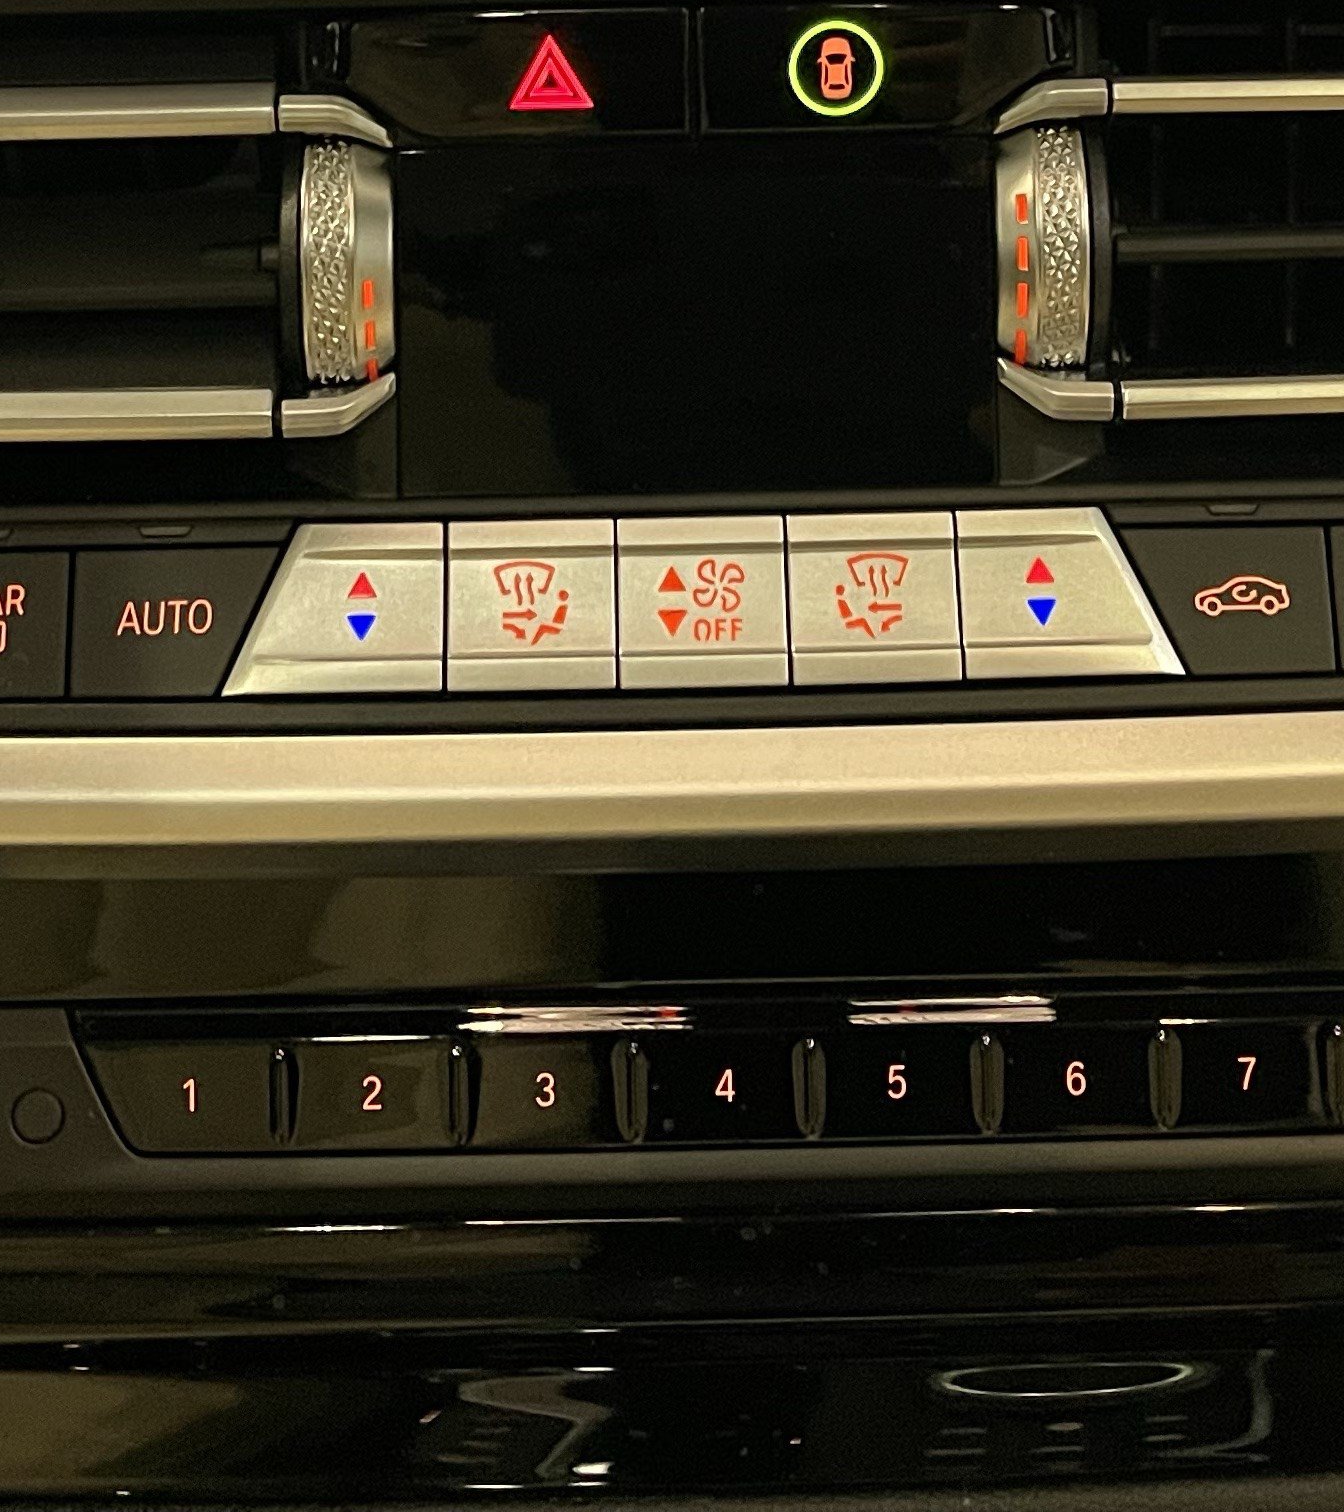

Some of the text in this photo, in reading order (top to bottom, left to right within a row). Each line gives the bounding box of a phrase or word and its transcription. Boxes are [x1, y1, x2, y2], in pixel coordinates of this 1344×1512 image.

[116, 598, 214, 636] AUTO
[693, 616, 744, 642] OFF
[534, 1071, 556, 1108] 3
[714, 1068, 737, 1103] 4
[887, 1063, 908, 1100] 5
[1065, 1060, 1087, 1097] 6
[1236, 1055, 1257, 1092] 7
[182, 1078, 197, 1112] 1
[361, 1075, 383, 1111] 2
